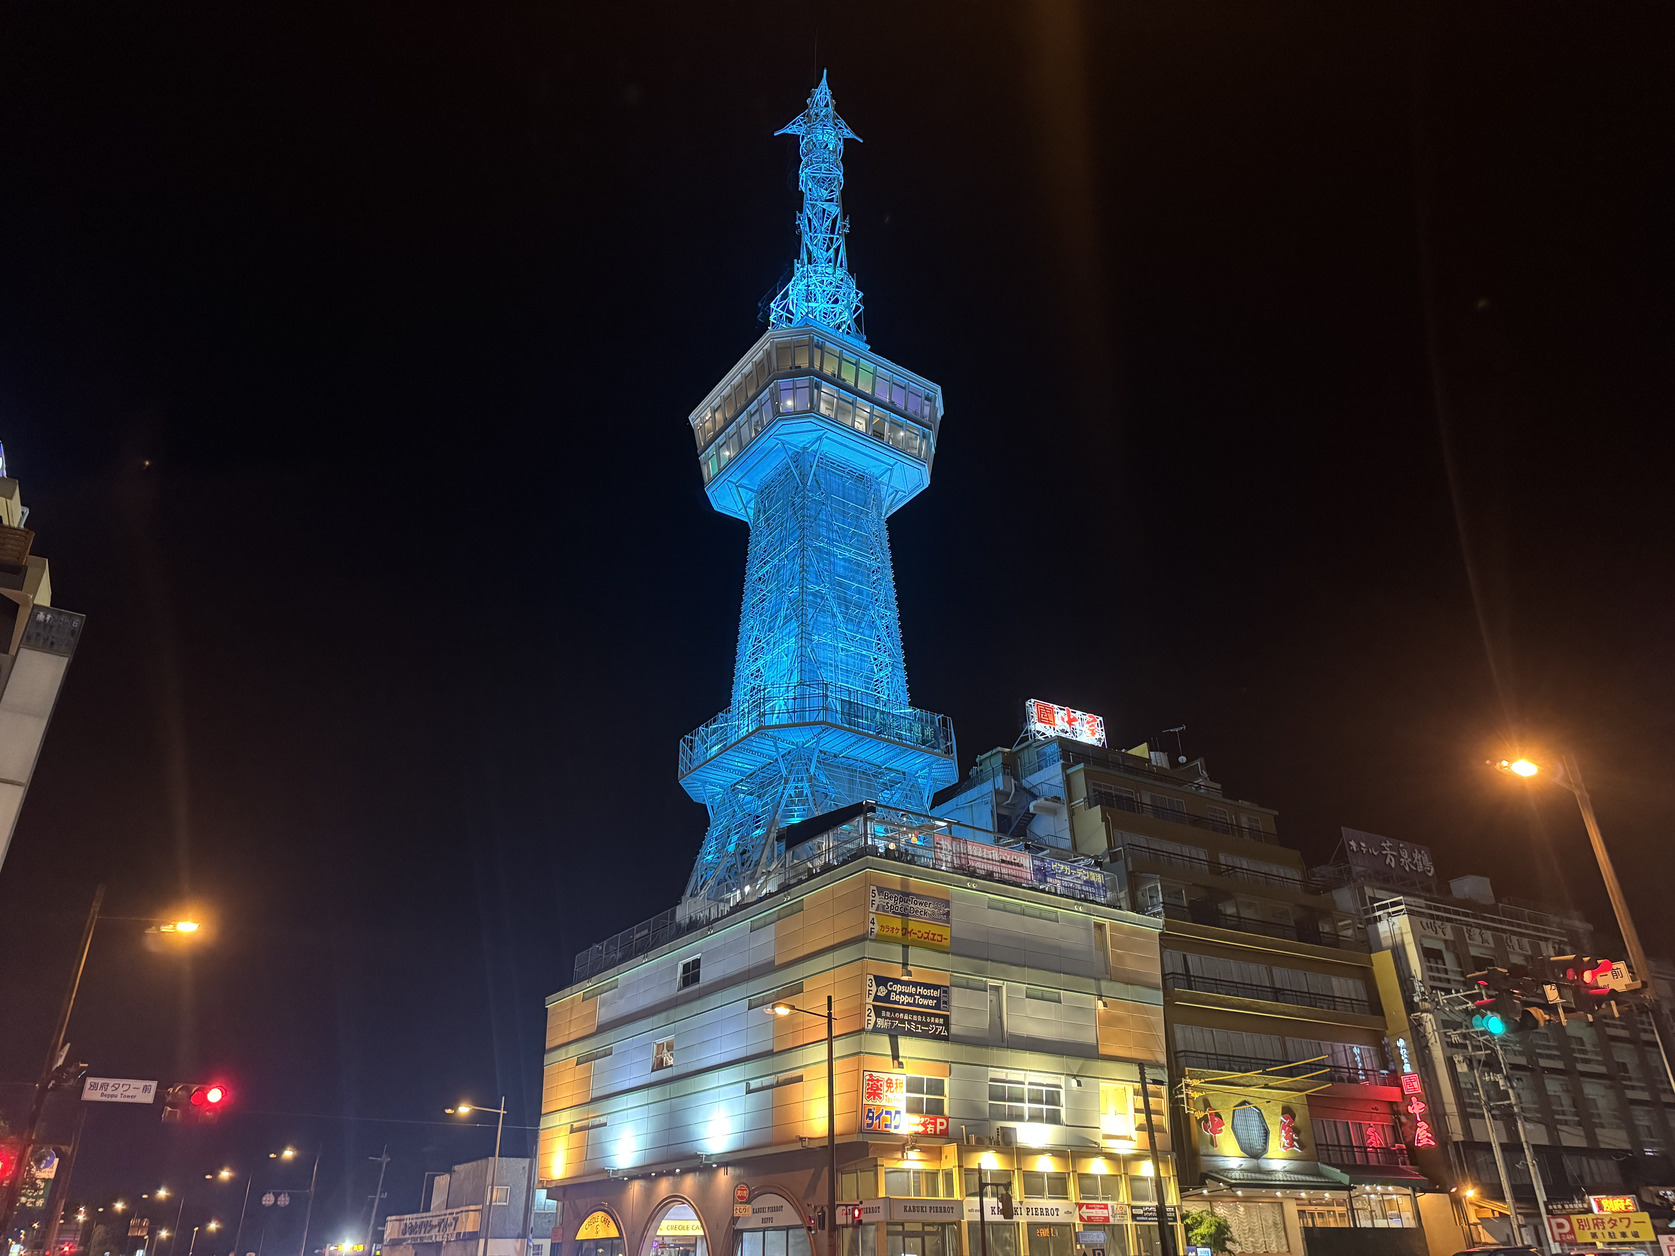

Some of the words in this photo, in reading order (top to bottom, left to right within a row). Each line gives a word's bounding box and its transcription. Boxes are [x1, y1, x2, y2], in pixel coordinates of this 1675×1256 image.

[883, 891, 908, 905] Beppu
[909, 896, 932, 908] Tower
[885, 902, 908, 914] Space
[908, 906, 929, 917] Deck
[879, 924, 901, 934] カラオケ
[887, 981, 916, 995] Capsule
[917, 985, 941, 997] Hostel
[889, 992, 914, 1005] Beppu
[914, 995, 937, 1007] Tower
[875, 1017, 948, 1036] 別府アートミュージアム
[88, 1081, 153, 1094] 別府タワー前
[865, 1074, 884, 1101] 薬
[885, 1077, 904, 1094] 免税
[865, 1107, 902, 1130] ダイコク
[903, 1205, 928, 1213] KABUKI
[928, 1206, 955, 1214] PIERROT
[990, 1206, 1023, 1216] KAKI
[1025, 1206, 1060, 1217] PIERROT
[1551, 1218, 1571, 1240] P
[1575, 1216, 1646, 1231] 別府タワー
[1590, 1230, 1641, 1240] 第1駐車場
